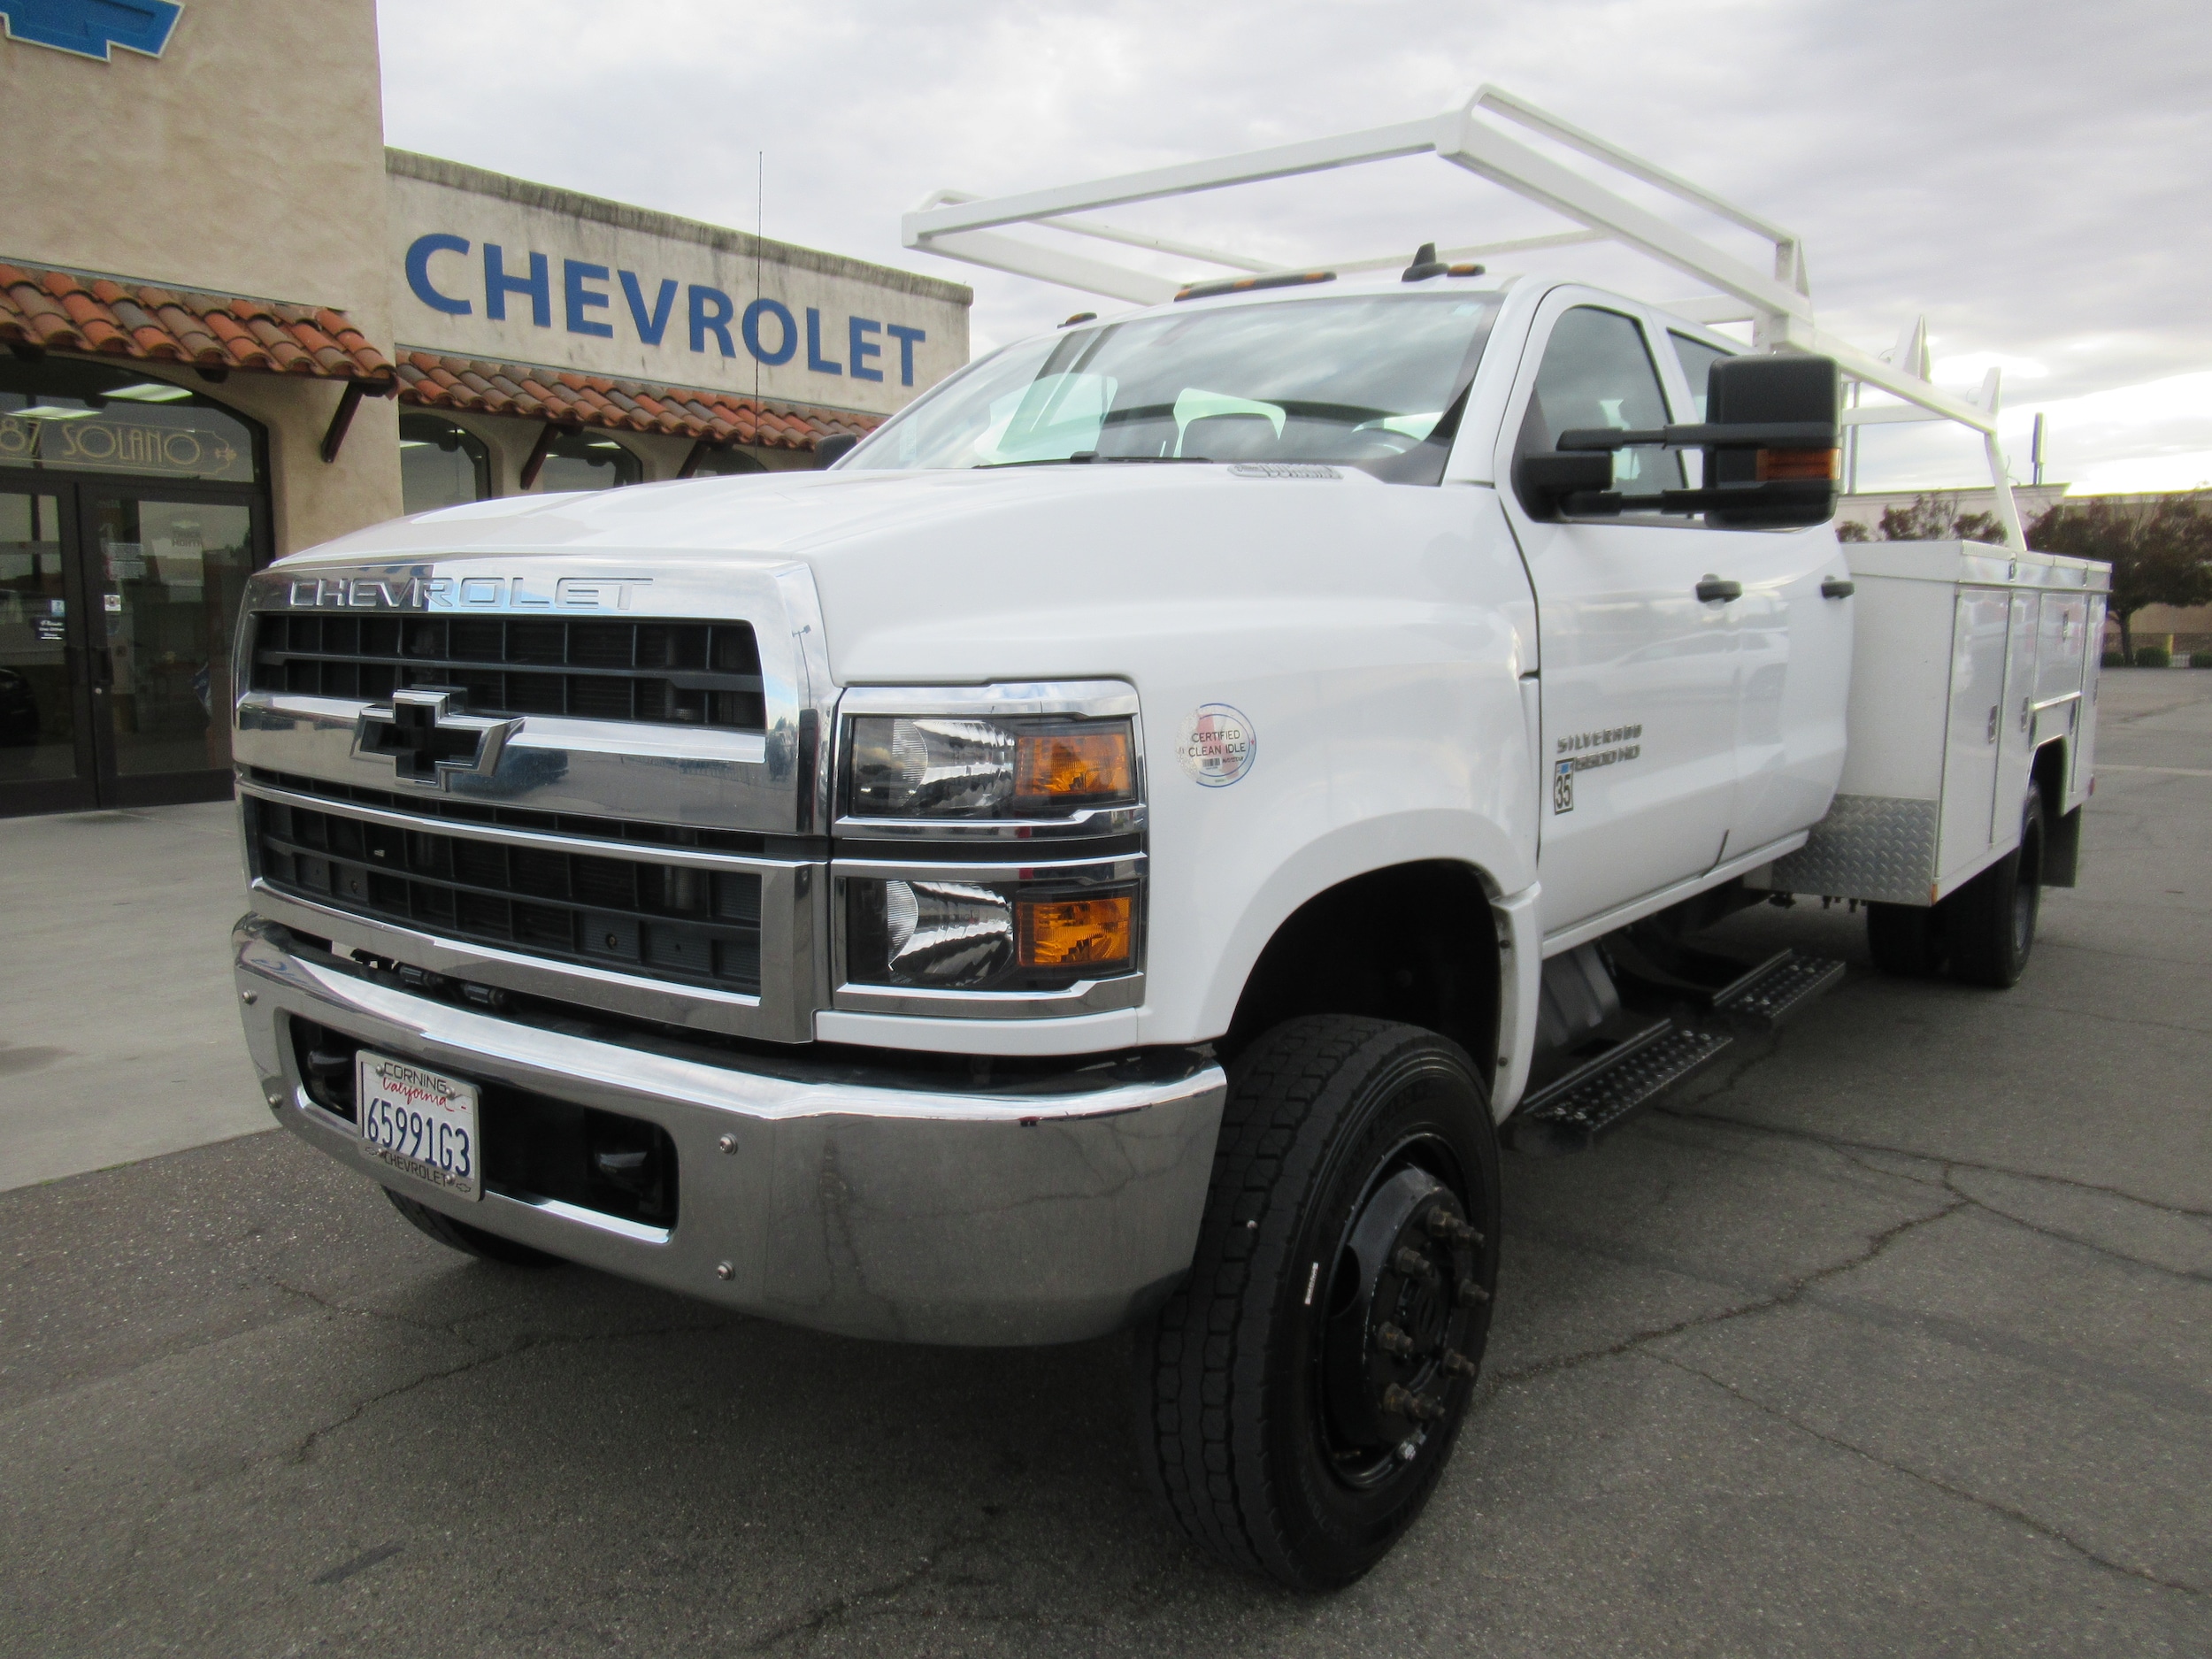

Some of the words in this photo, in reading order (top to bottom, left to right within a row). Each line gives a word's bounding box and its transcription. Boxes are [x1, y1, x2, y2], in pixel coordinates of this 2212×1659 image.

[405, 233, 926, 387] CHEVROLET
[61, 422, 202, 465] SOLANO
[290, 577, 655, 611] CHEVROLET
[1188, 744, 1222, 757] CLEAN
[1225, 742, 1246, 753] IDLE
[1191, 729, 1240, 743] CERTIFIED
[1555, 773, 1571, 809] 35
[382, 1062, 448, 1094] CORNING
[382, 1077, 455, 1112] California
[367, 1097, 471, 1178] 65991G3
[384, 1151, 449, 1187] CHEVROLET
